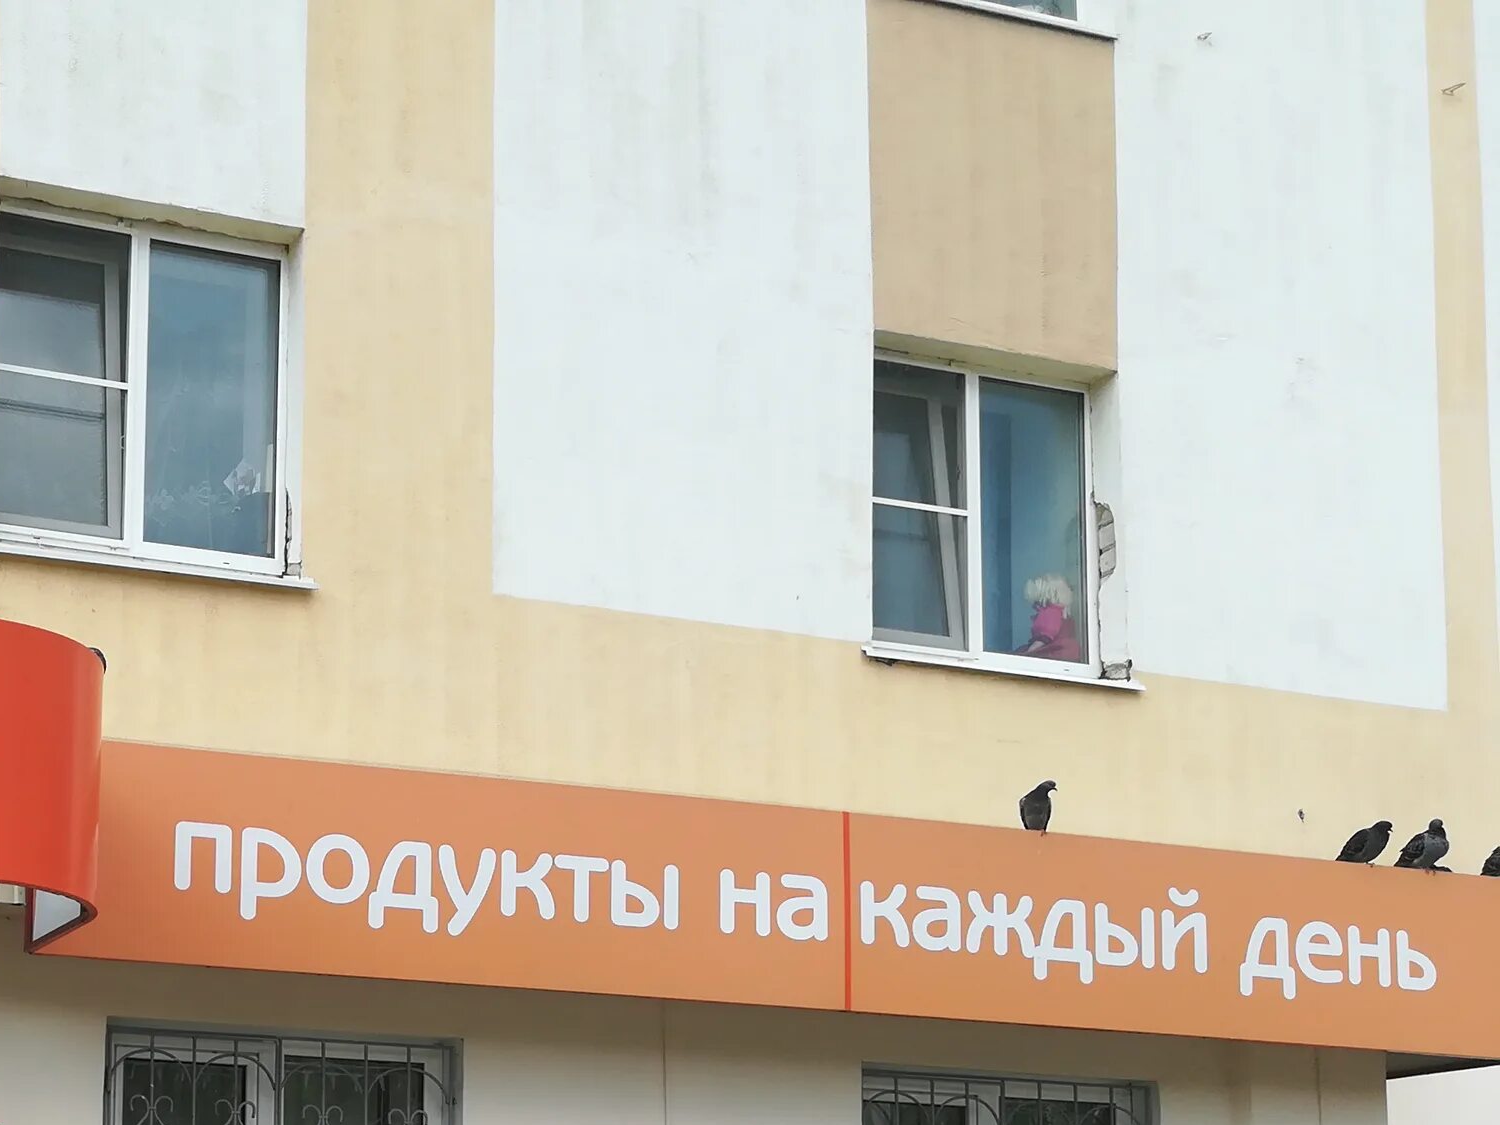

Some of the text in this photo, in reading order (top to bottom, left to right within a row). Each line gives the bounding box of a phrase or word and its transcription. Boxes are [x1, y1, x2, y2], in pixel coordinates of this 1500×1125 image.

[173, 820, 1437, 1000] продукты на каждый день
